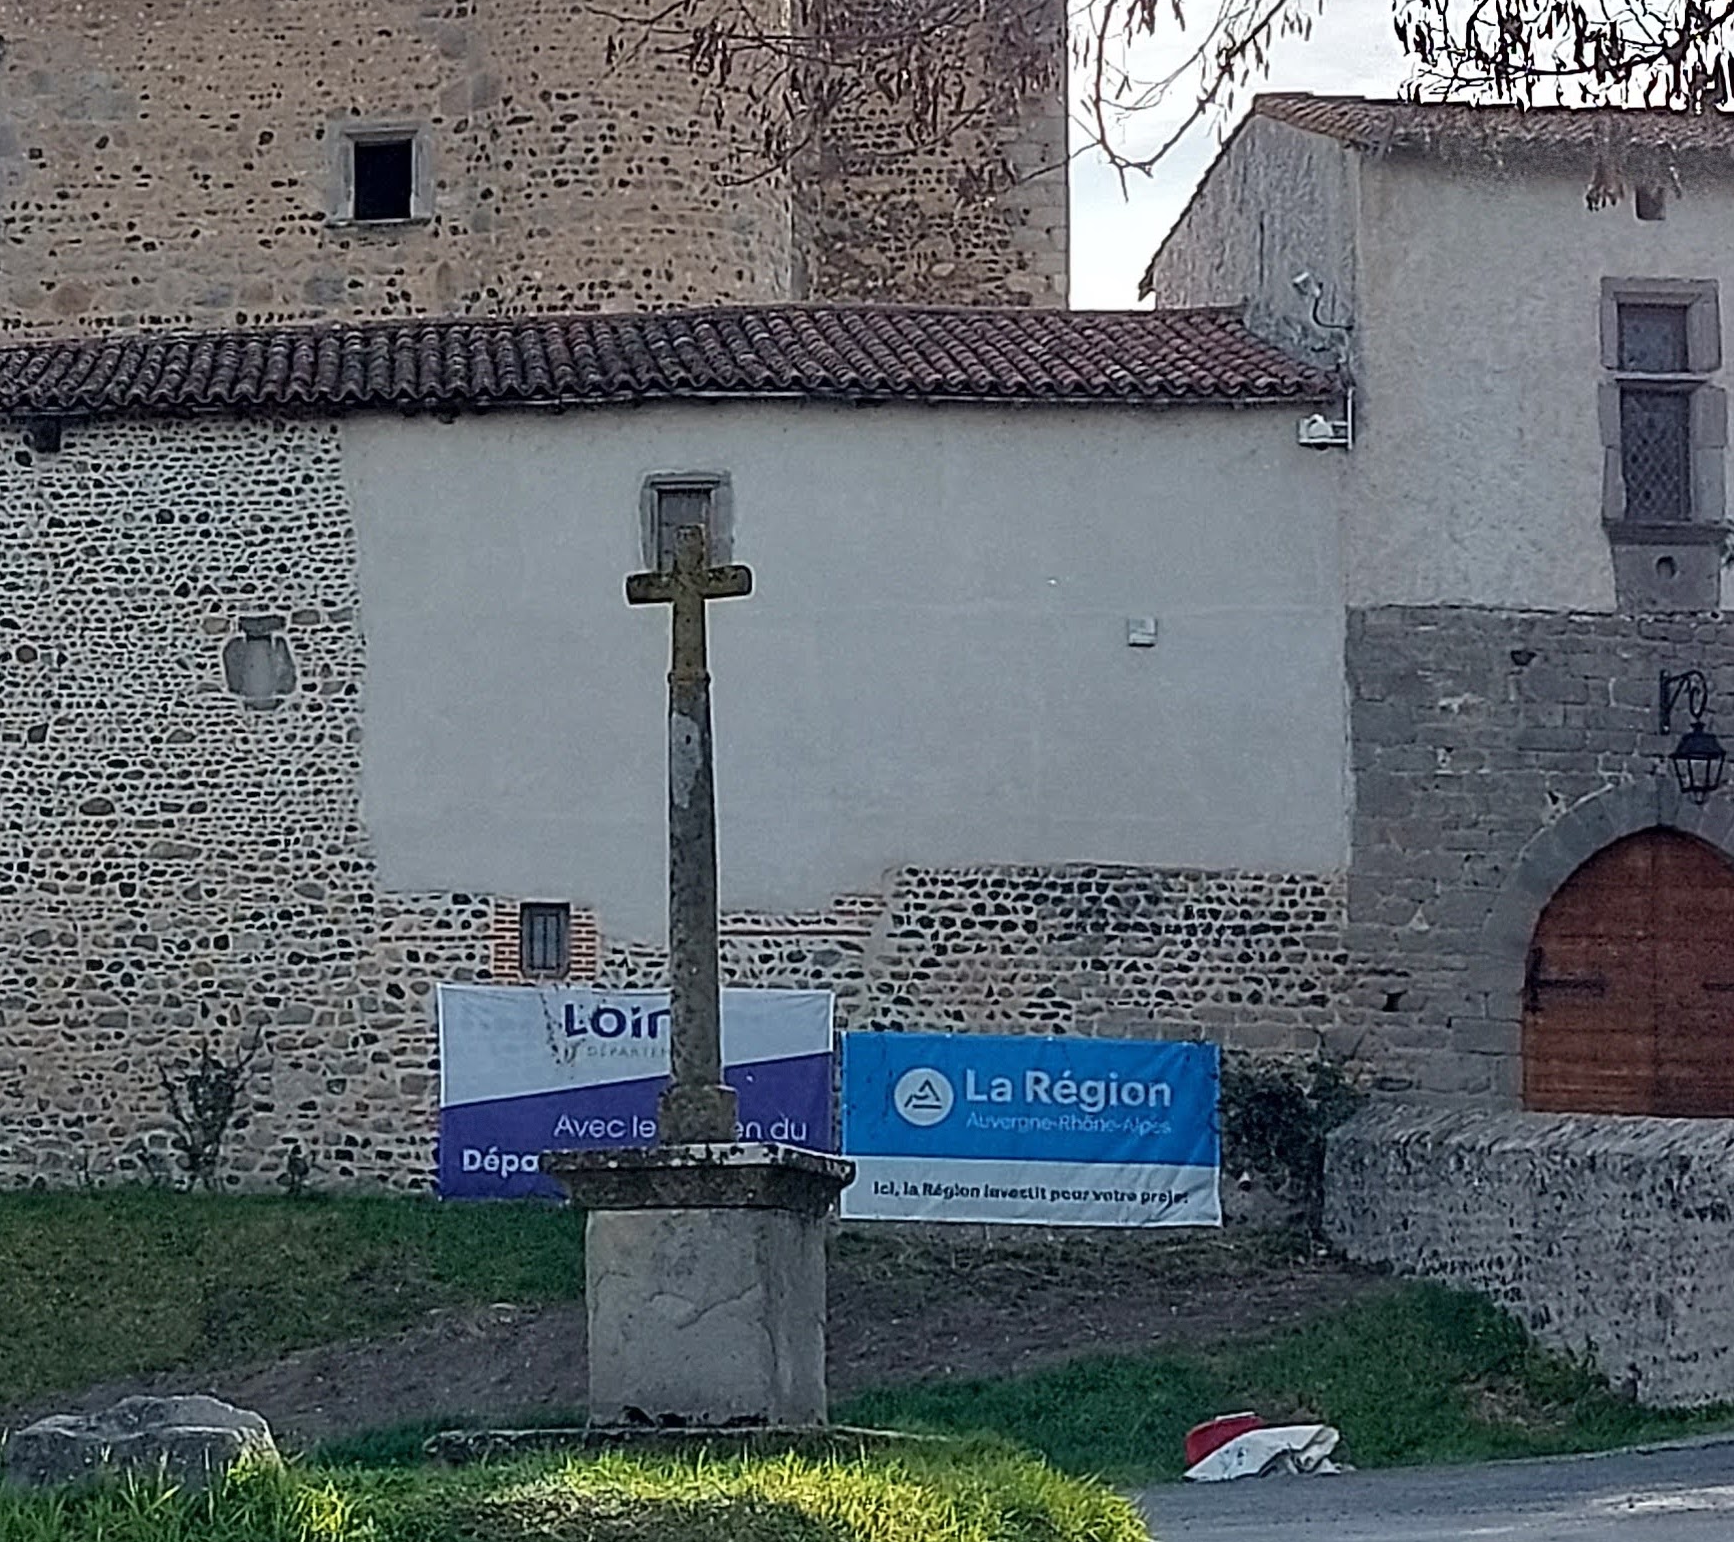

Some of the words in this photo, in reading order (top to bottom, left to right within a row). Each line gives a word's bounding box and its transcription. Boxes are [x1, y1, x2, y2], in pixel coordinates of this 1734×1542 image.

[565, 1004, 670, 1039] Loir
[966, 1069, 1013, 1103] La
[1025, 1070, 1172, 1114] Région
[553, 1115, 627, 1138] Avec
[632, 1115, 657, 1138] le
[770, 1118, 807, 1141] du
[462, 1146, 540, 1179] Dépa
[873, 1180, 900, 1197] Ici,
[903, 1181, 920, 1197] la
[922, 1181, 982, 1200] Région
[1050, 1189, 1089, 1203] pour
[1092, 1189, 1138, 1203] votre
